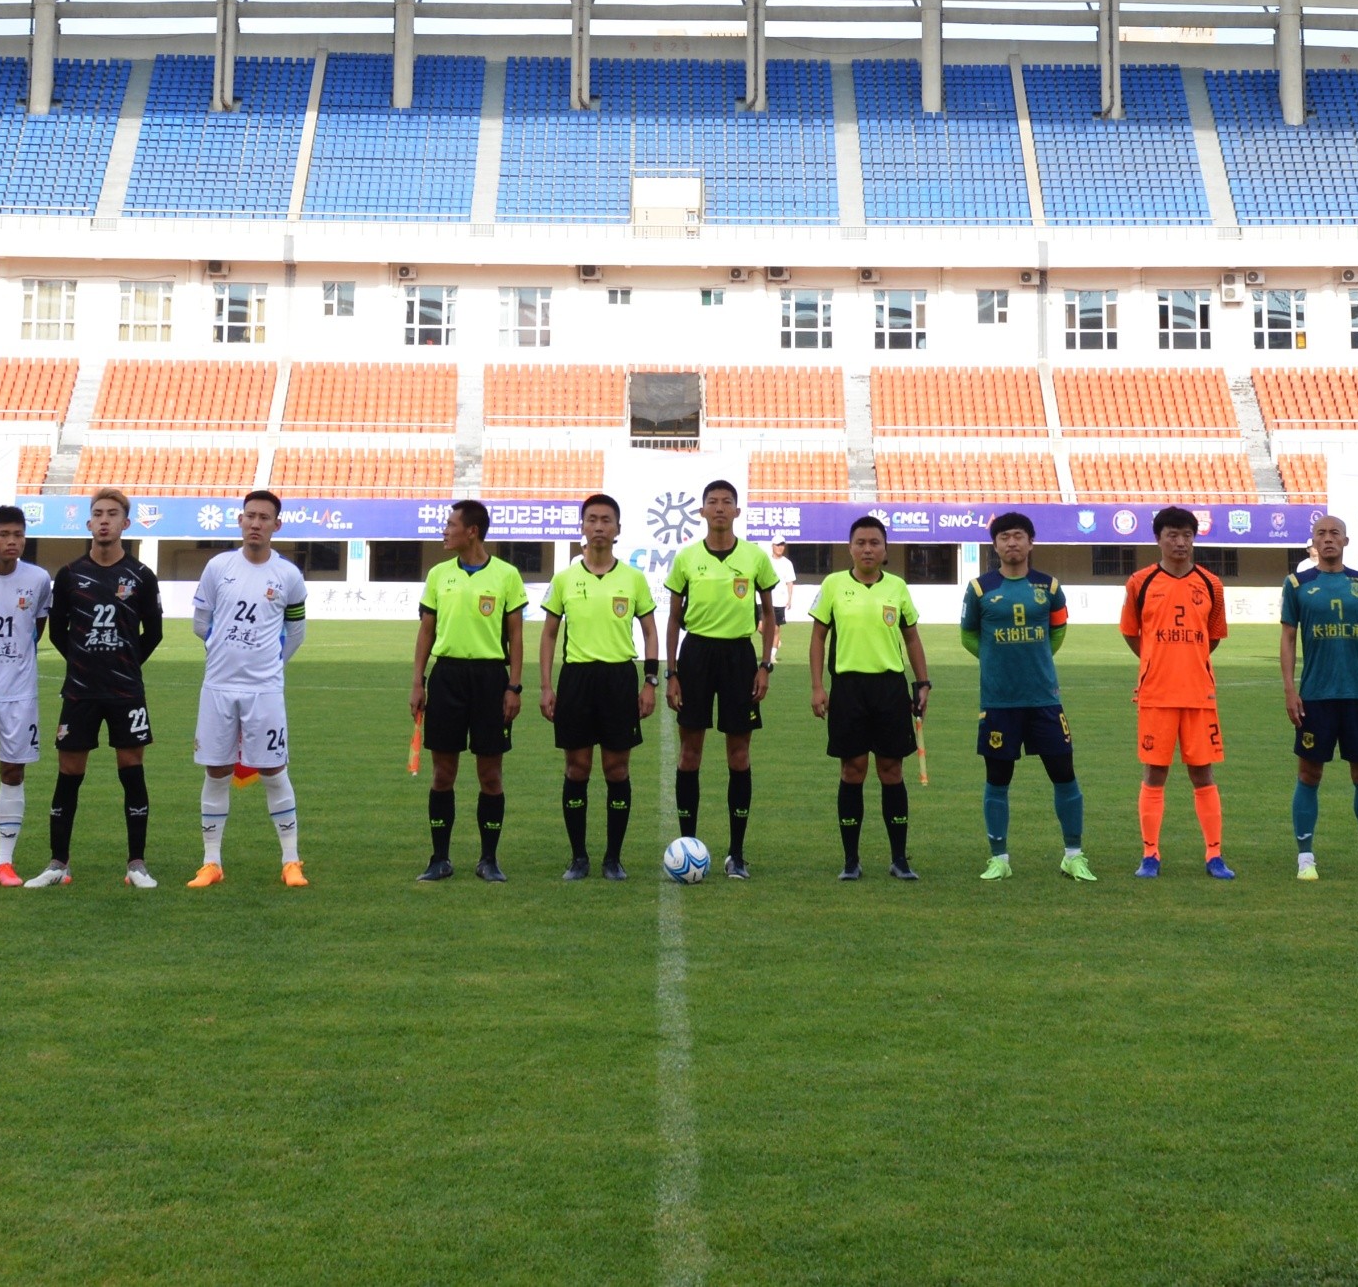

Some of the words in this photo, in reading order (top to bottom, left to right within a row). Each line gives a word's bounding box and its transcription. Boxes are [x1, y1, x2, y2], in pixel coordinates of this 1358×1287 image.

[892, 512, 929, 524] CMCL
[92, 603, 116, 628] 22
[234, 600, 257, 624] 24
[1013, 603, 1026, 626] 8
[1174, 605, 1185, 626] 2
[1330, 599, 1343, 619] 7
[994, 627, 1045, 642] 长治汇承
[1155, 629, 1204, 643] 长治汇承
[128, 707, 150, 734] 22
[266, 729, 285, 751] 24
[1209, 724, 1219, 746] 2
